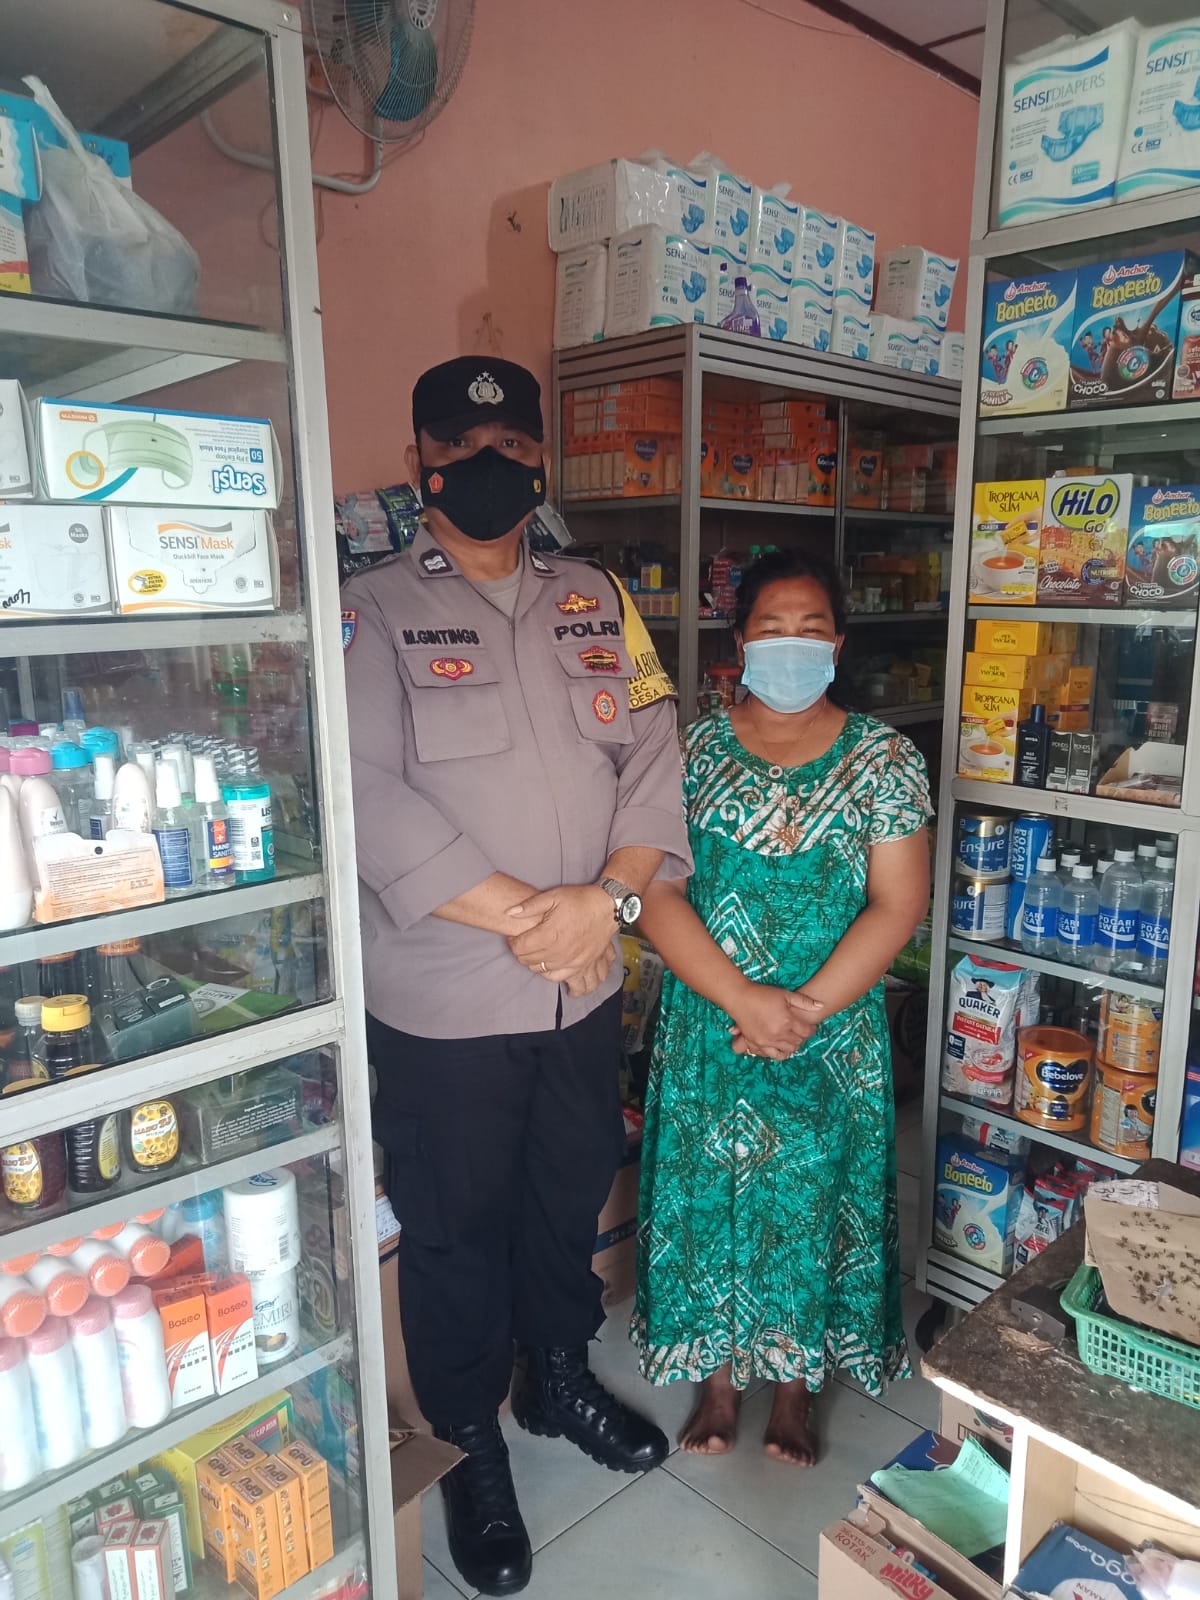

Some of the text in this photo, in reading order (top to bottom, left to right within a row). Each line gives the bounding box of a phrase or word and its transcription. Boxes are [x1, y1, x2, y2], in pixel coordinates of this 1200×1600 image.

[1147, 53, 1187, 76] SENSI
[1014, 91, 1050, 114] SENSI
[1051, 73, 1106, 104] DIAPERS
[666, 248, 688, 261] SENSI
[1117, 264, 1150, 281] Anchor
[1018, 281, 1048, 296] Anchor
[1092, 277, 1162, 309] Boneeto
[996, 291, 1058, 323] Boneeto
[1073, 383, 1108, 397] CHOCO
[251, 450, 262, 461] 50
[212, 465, 267, 496] Sensi
[988, 490, 1040, 506] TROPICANA
[1058, 485, 1114, 521] HiLo
[999, 501, 1021, 514] SLIM
[159, 536, 234, 550] SENSI Mask
[1039, 575, 1082, 592] Chocolate
[1129, 585, 1163, 598] CHOCO
[553, 620, 621, 646] POLRI
[630, 688, 662, 708] DESA
[974, 692, 1017, 706] TROPICANA
[983, 702, 1001, 713] SLIM
[960, 839, 1005, 854] Ensure
[1015, 828, 1028, 877] POCARI
[1099, 915, 1135, 928] POCARI
[1099, 921, 1131, 935] SWEAT
[958, 996, 1001, 1019] QUAKER
[1041, 1065, 1085, 1082] Bebelove
[951, 1157, 985, 1174] Anchor
[943, 1163, 994, 1194] Boneeto
[231, 1442, 256, 1460] GPU
[288, 1448, 313, 1467] GPU
[208, 1457, 233, 1478] GPU
[264, 1463, 288, 1483] GPU
[238, 1477, 264, 1498] GPU
[834, 1533, 871, 1561] KOTAK
